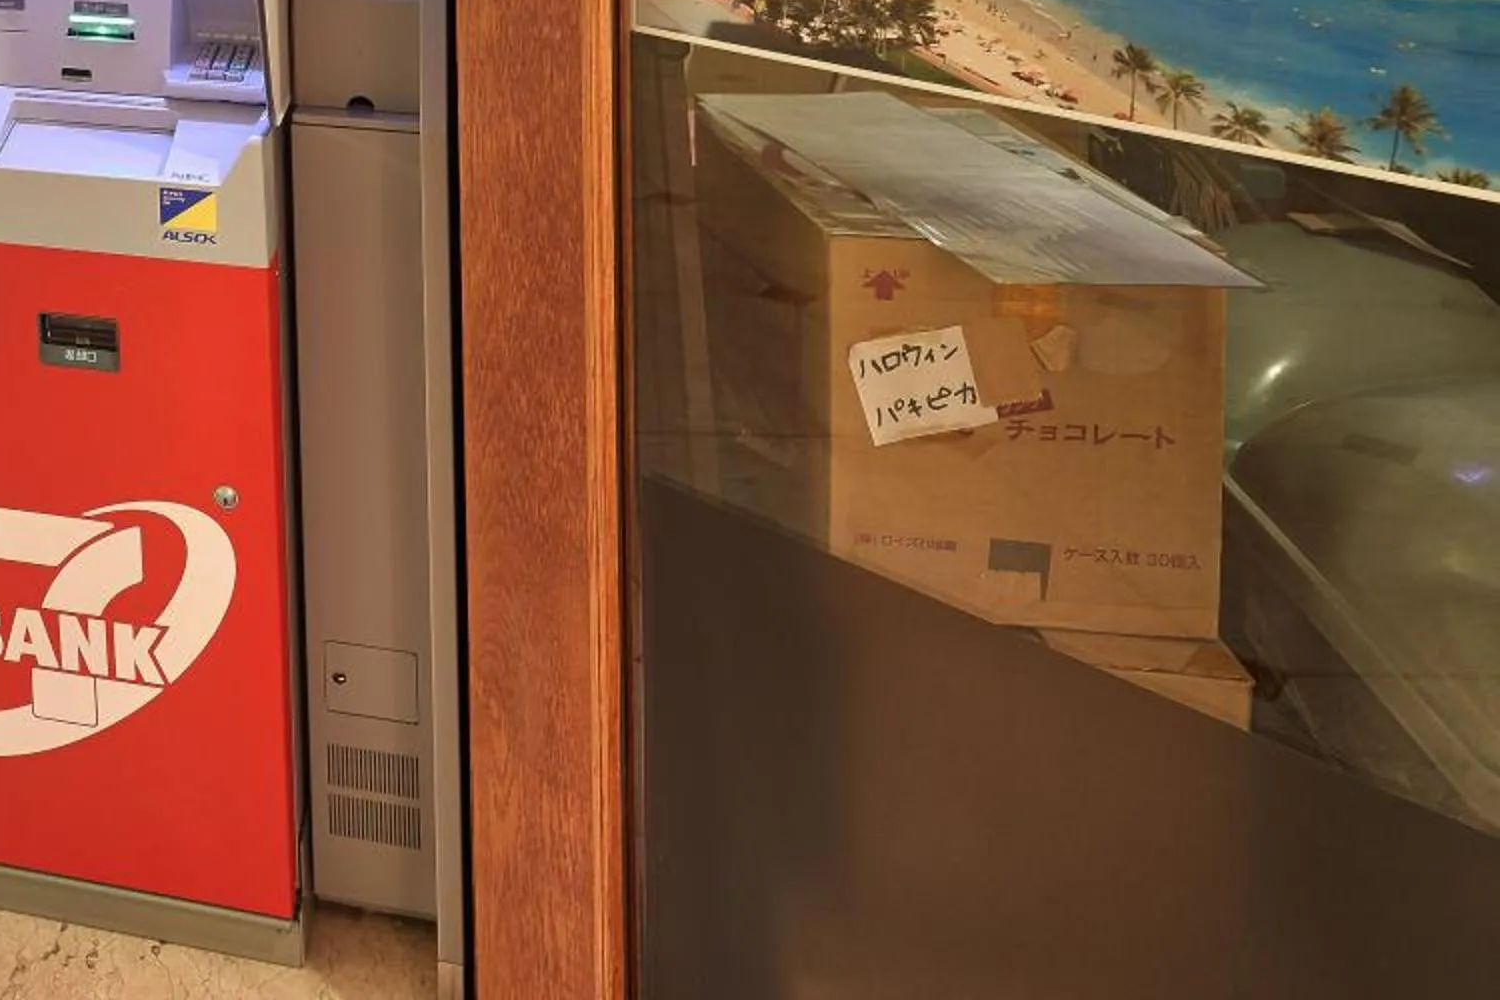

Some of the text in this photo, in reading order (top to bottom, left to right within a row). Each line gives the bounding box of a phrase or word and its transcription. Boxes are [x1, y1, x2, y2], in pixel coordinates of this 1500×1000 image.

[163, 231, 217, 245] ALSOK
[876, 382, 978, 428] パキピカ
[1005, 418, 1175, 450] チョコレート
